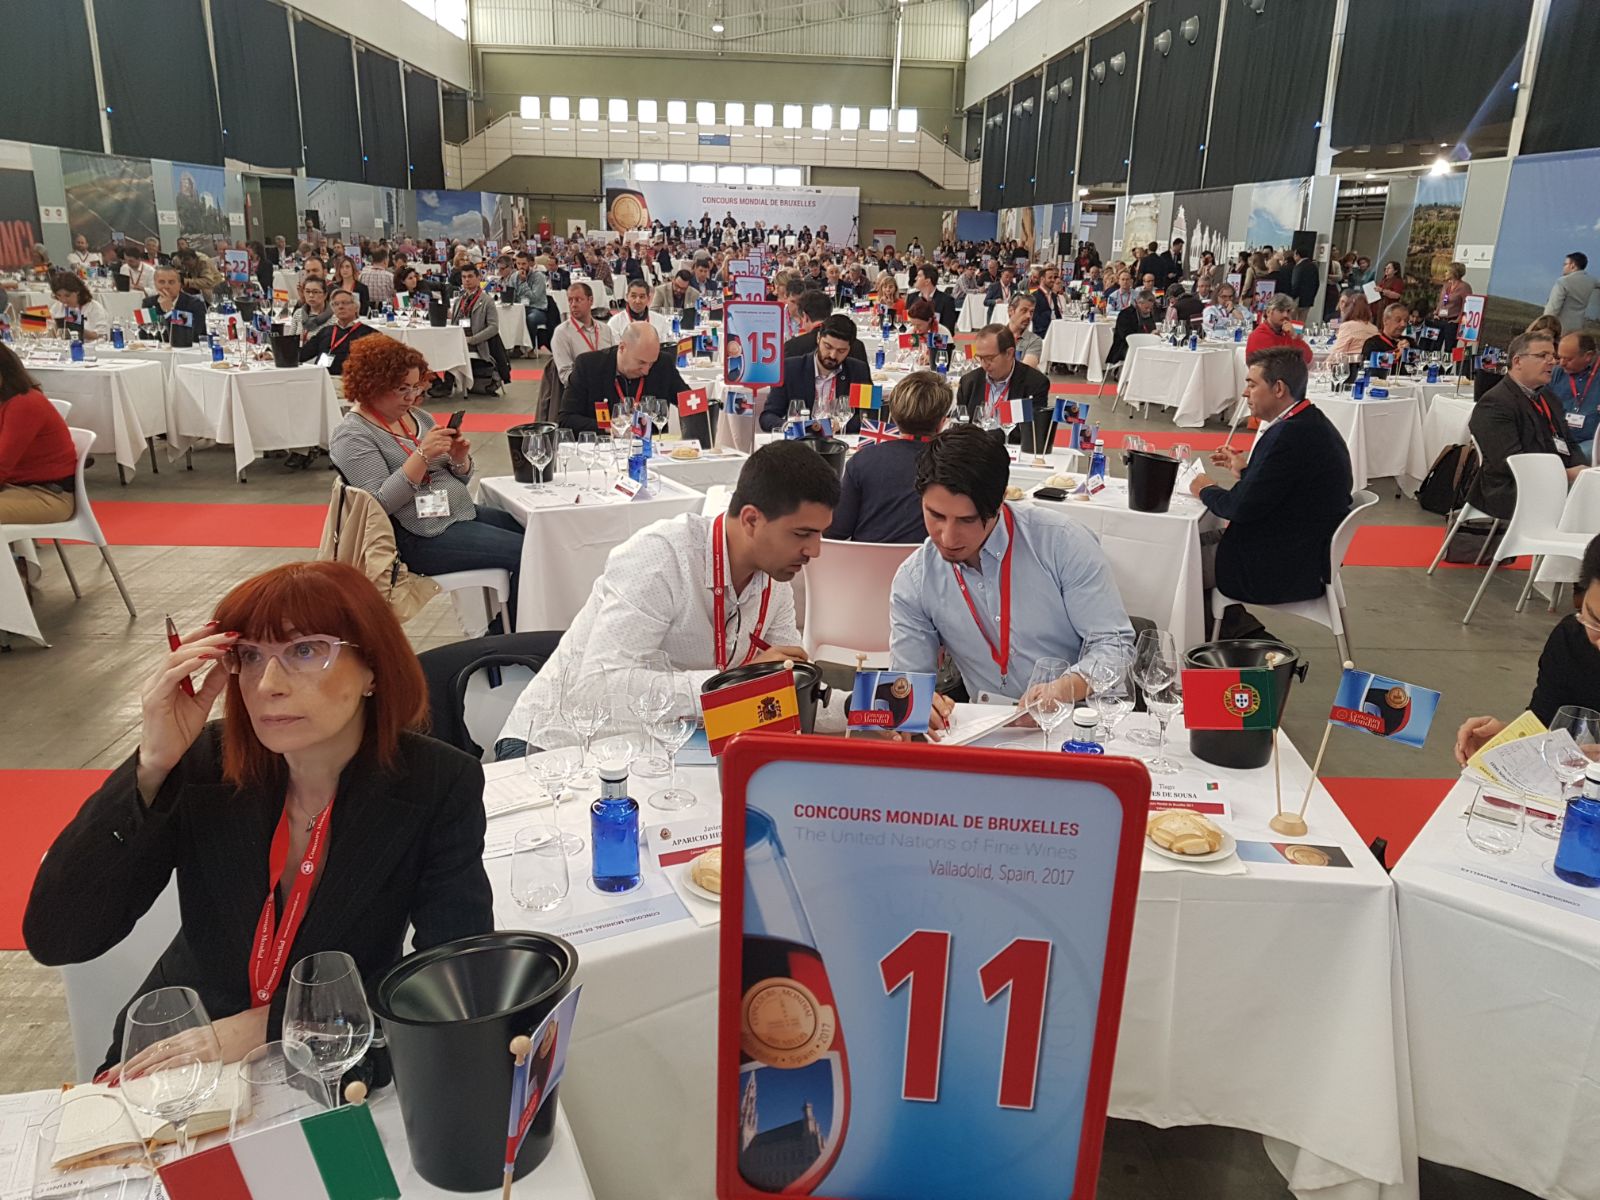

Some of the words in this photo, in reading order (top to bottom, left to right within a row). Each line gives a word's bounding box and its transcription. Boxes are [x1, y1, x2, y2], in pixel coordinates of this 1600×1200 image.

[702, 196, 738, 205] CONCOURS
[740, 198, 769, 206] MONDIAL
[780, 200, 816, 208] BRUXELLES
[233, 260, 246, 274] 22
[750, 264, 760, 275] 27
[1466, 311, 1480, 329] 20
[747, 332, 777, 364] 15
[794, 804, 881, 822] CONCOURS
[886, 810, 958, 828] MONDIAL
[963, 815, 983, 830] DE
[988, 817, 1080, 837] BRUXELLES
[309, 830, 321, 860] Concours
[672, 834, 708, 847] APARICIO
[794, 826, 826, 843] The
[830, 829, 885, 847] United
[890, 833, 956, 851] Nations
[962, 837, 980, 852] of
[984, 839, 1018, 856] Fine
[1024, 842, 1078, 861] Wines
[929, 860, 994, 881] Valladolid,
[999, 864, 1037, 884] Spain,
[1042, 867, 1075, 886] 2017
[274, 940, 286, 967] Mondial
[818, 1022, 831, 1044] 2017
[878, 929, 1053, 1111] 11
